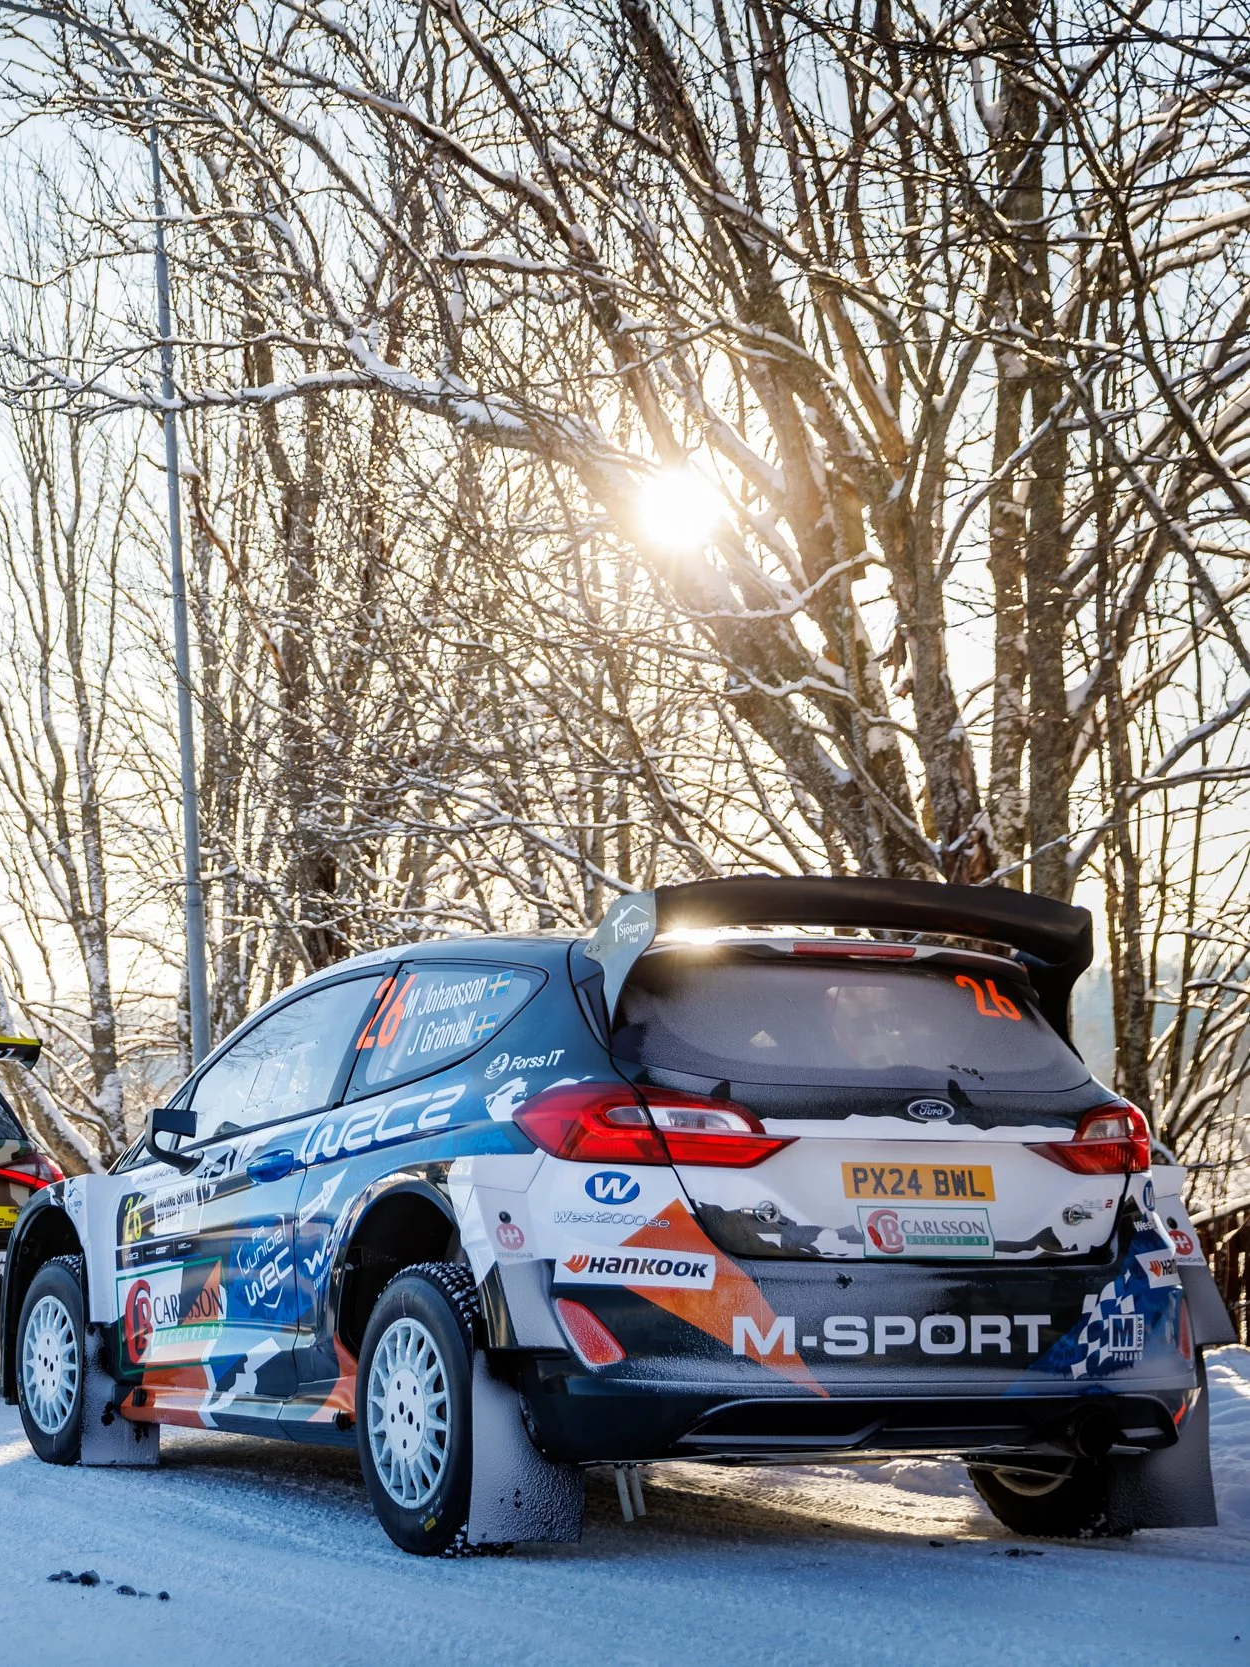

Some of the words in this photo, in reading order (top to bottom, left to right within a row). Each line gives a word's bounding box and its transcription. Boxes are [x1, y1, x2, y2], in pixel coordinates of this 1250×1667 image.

[618, 921, 649, 940] Sjötorps
[355, 973, 417, 1050] 26
[402, 993, 416, 1020] M
[418, 976, 487, 1017] Johansson
[955, 974, 1022, 1021] 26
[407, 1023, 421, 1057] J
[422, 1011, 477, 1054] Grönvall
[508, 1055, 547, 1071] Forss
[546, 1049, 565, 1067] IT
[918, 1103, 945, 1116] Ford
[852, 1167, 923, 1195] PX24
[933, 1169, 986, 1197] BWL
[124, 1194, 143, 1242] 26
[901, 1219, 986, 1235] CARLSSON
[244, 1246, 294, 1306] WRC
[733, 1314, 1052, 1356] M-SPORT
[1136, 1316, 1144, 1348] SPORT
[1114, 1351, 1144, 1362] POLAND
